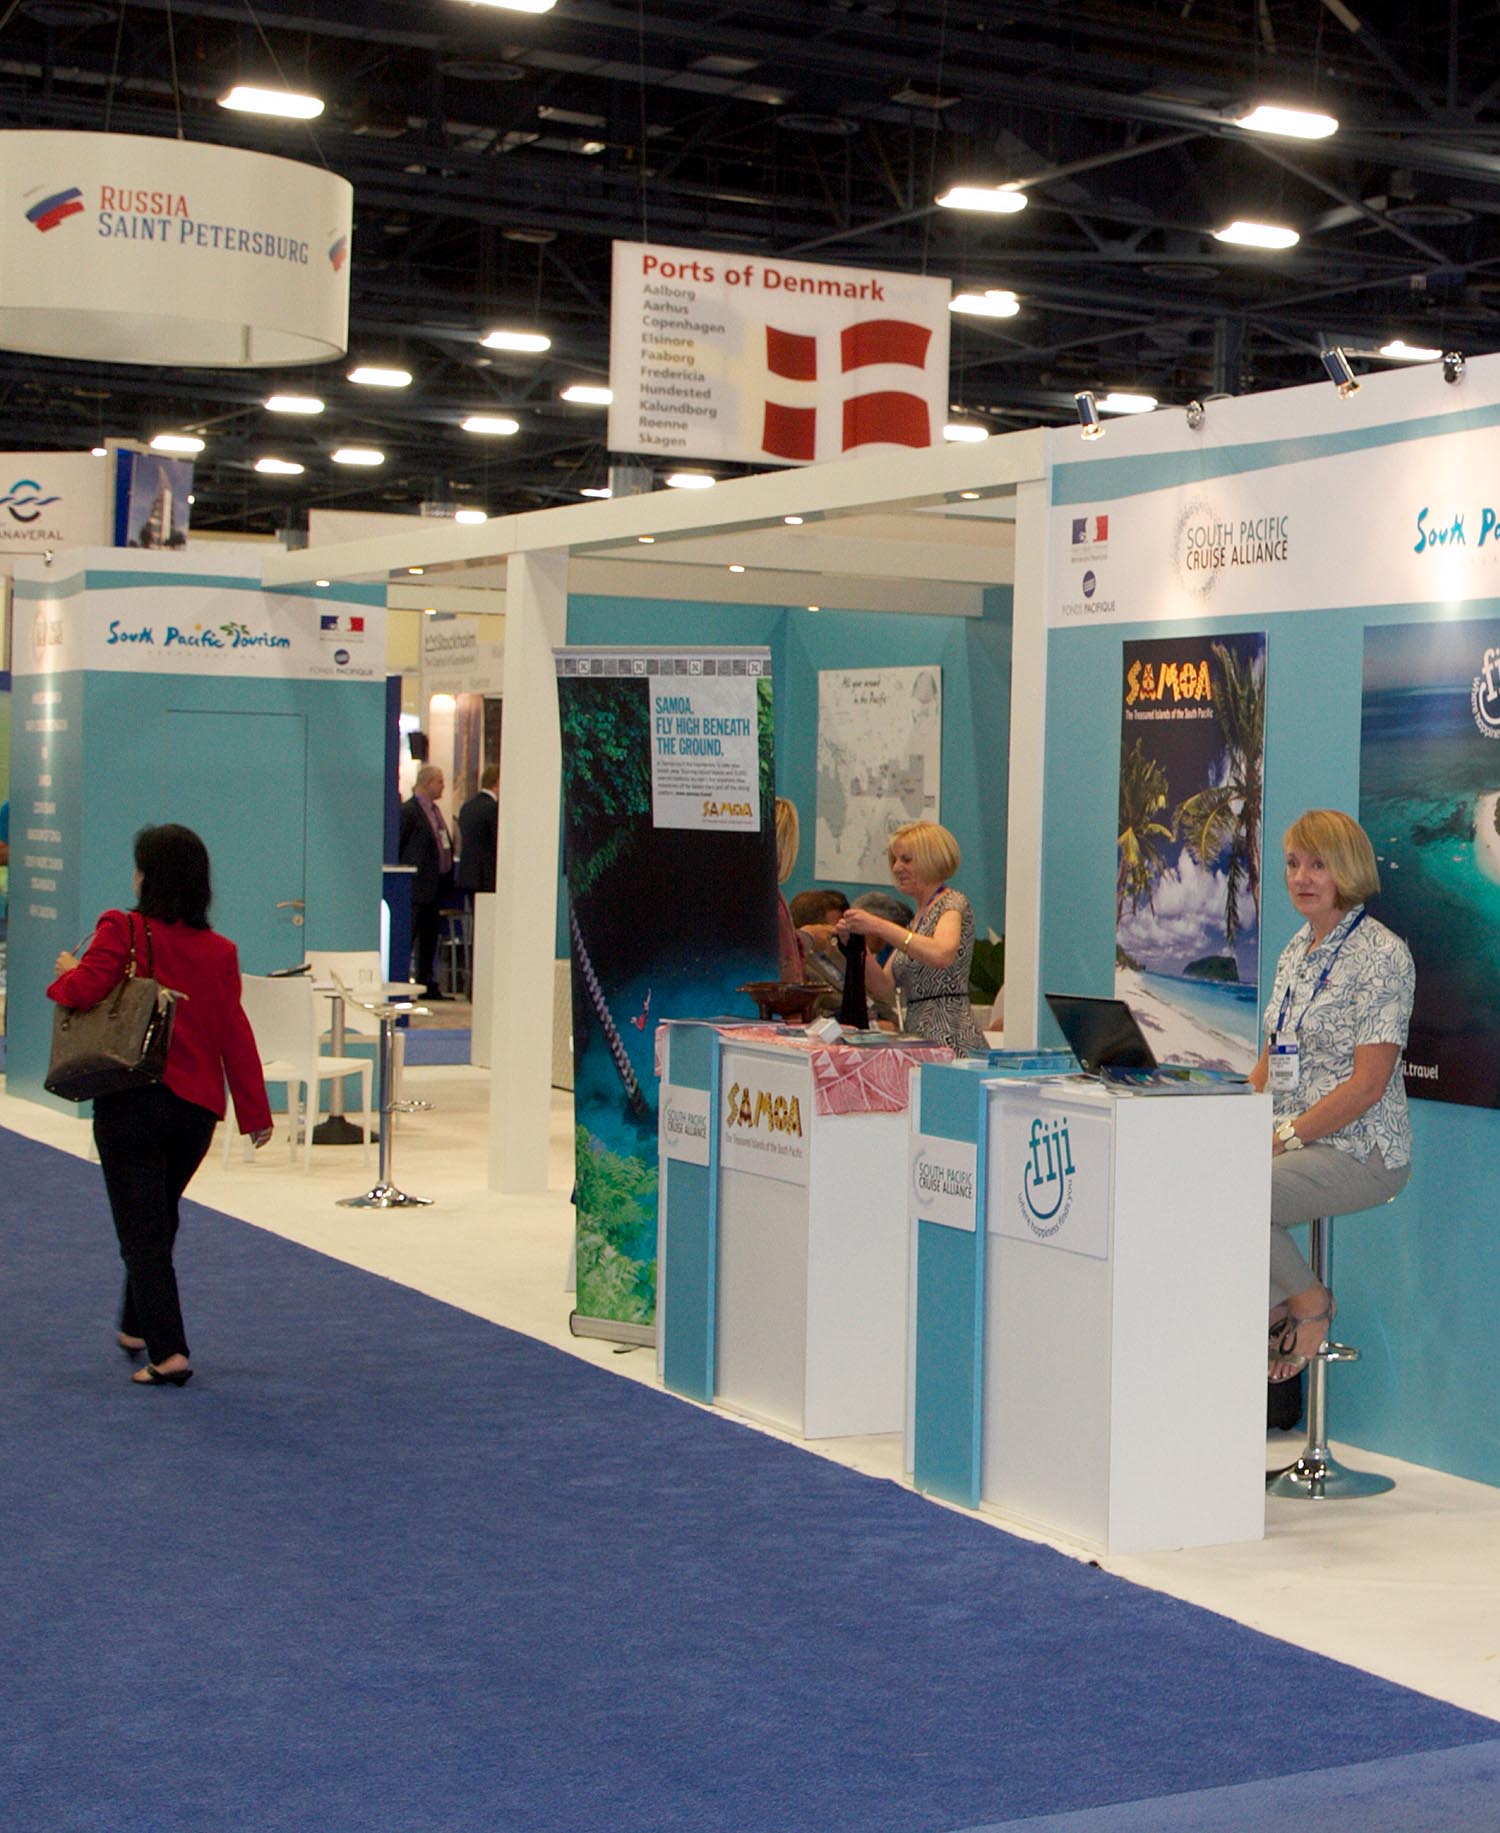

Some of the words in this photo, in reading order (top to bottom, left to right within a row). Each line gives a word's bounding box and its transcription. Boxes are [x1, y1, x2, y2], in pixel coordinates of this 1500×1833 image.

[100, 185, 190, 218] RUSSIA
[98, 212, 172, 242] SAINT
[180, 218, 309, 265] PETERSBURG
[642, 255, 715, 283] Ports
[724, 264, 754, 287] of
[763, 268, 886, 302] Denmark
[643, 283, 696, 301] Aalborg
[643, 299, 690, 315] Aarhus
[642, 315, 725, 335] Copenhagen
[641, 333, 695, 348] Elsinore
[641, 349, 695, 366] Faaborg
[640, 366, 705, 383] Fredericia
[640, 383, 711, 400] Hundested
[639, 400, 717, 419] Kalundborg
[638, 416, 689, 431] Roenne
[638, 432, 687, 449] Skagen
[0, 532, 64, 542] NAVERAL
[1186, 520, 1234, 551] SOUTH
[1240, 516, 1289, 543] PACIFIC
[1413, 506, 1466, 554] South
[1186, 546, 1226, 571] CRUISE
[1231, 540, 1288, 567] ALLIANCE
[105, 620, 155, 645] South
[164, 626, 225, 649] Pacific
[222, 623, 291, 649] Tourism
[1126, 659, 1213, 706] SAMOA
[655, 697, 695, 715] SAMOA.
[656, 717, 673, 735] FLY
[676, 718, 700, 736] HIGH
[703, 718, 750, 736] BENEATH
[656, 737, 676, 755] THE
[678, 738, 725, 756] GROUND.
[703, 800, 752, 817] SAMOA
[726, 1082, 803, 1138] SAMOA
[919, 1162, 945, 1180] SOUTH
[946, 1168, 973, 1185] PACIFIC
[919, 1177, 941, 1192] CRUISE
[942, 1180, 972, 1200] ALLIANCE
